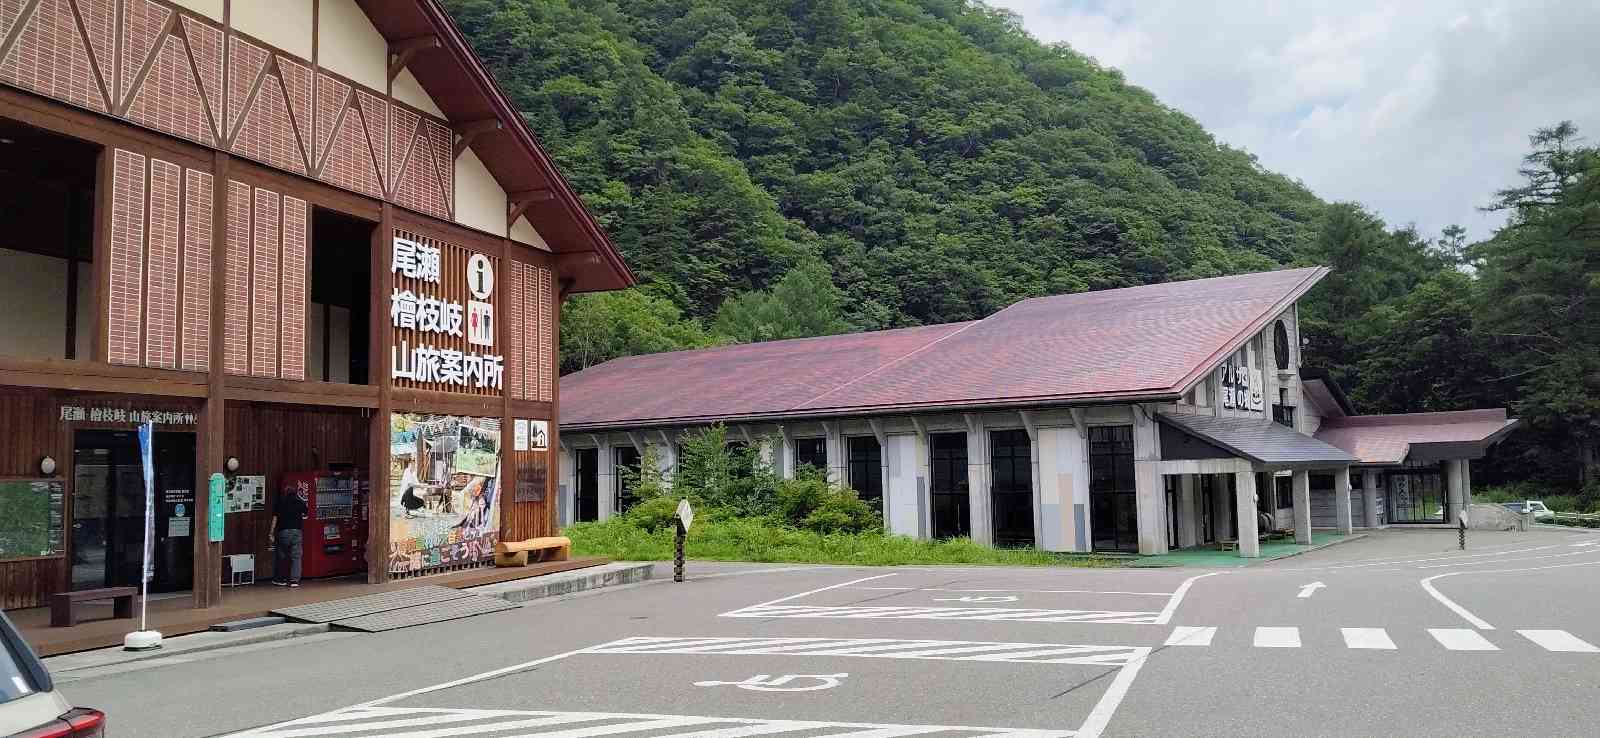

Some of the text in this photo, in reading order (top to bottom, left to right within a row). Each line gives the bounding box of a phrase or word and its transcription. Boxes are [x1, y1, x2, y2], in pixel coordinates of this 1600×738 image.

[391, 236, 441, 285] 尾瀬
[390, 287, 464, 338] 檜枝岐
[391, 340, 505, 391] 山旅案内所
